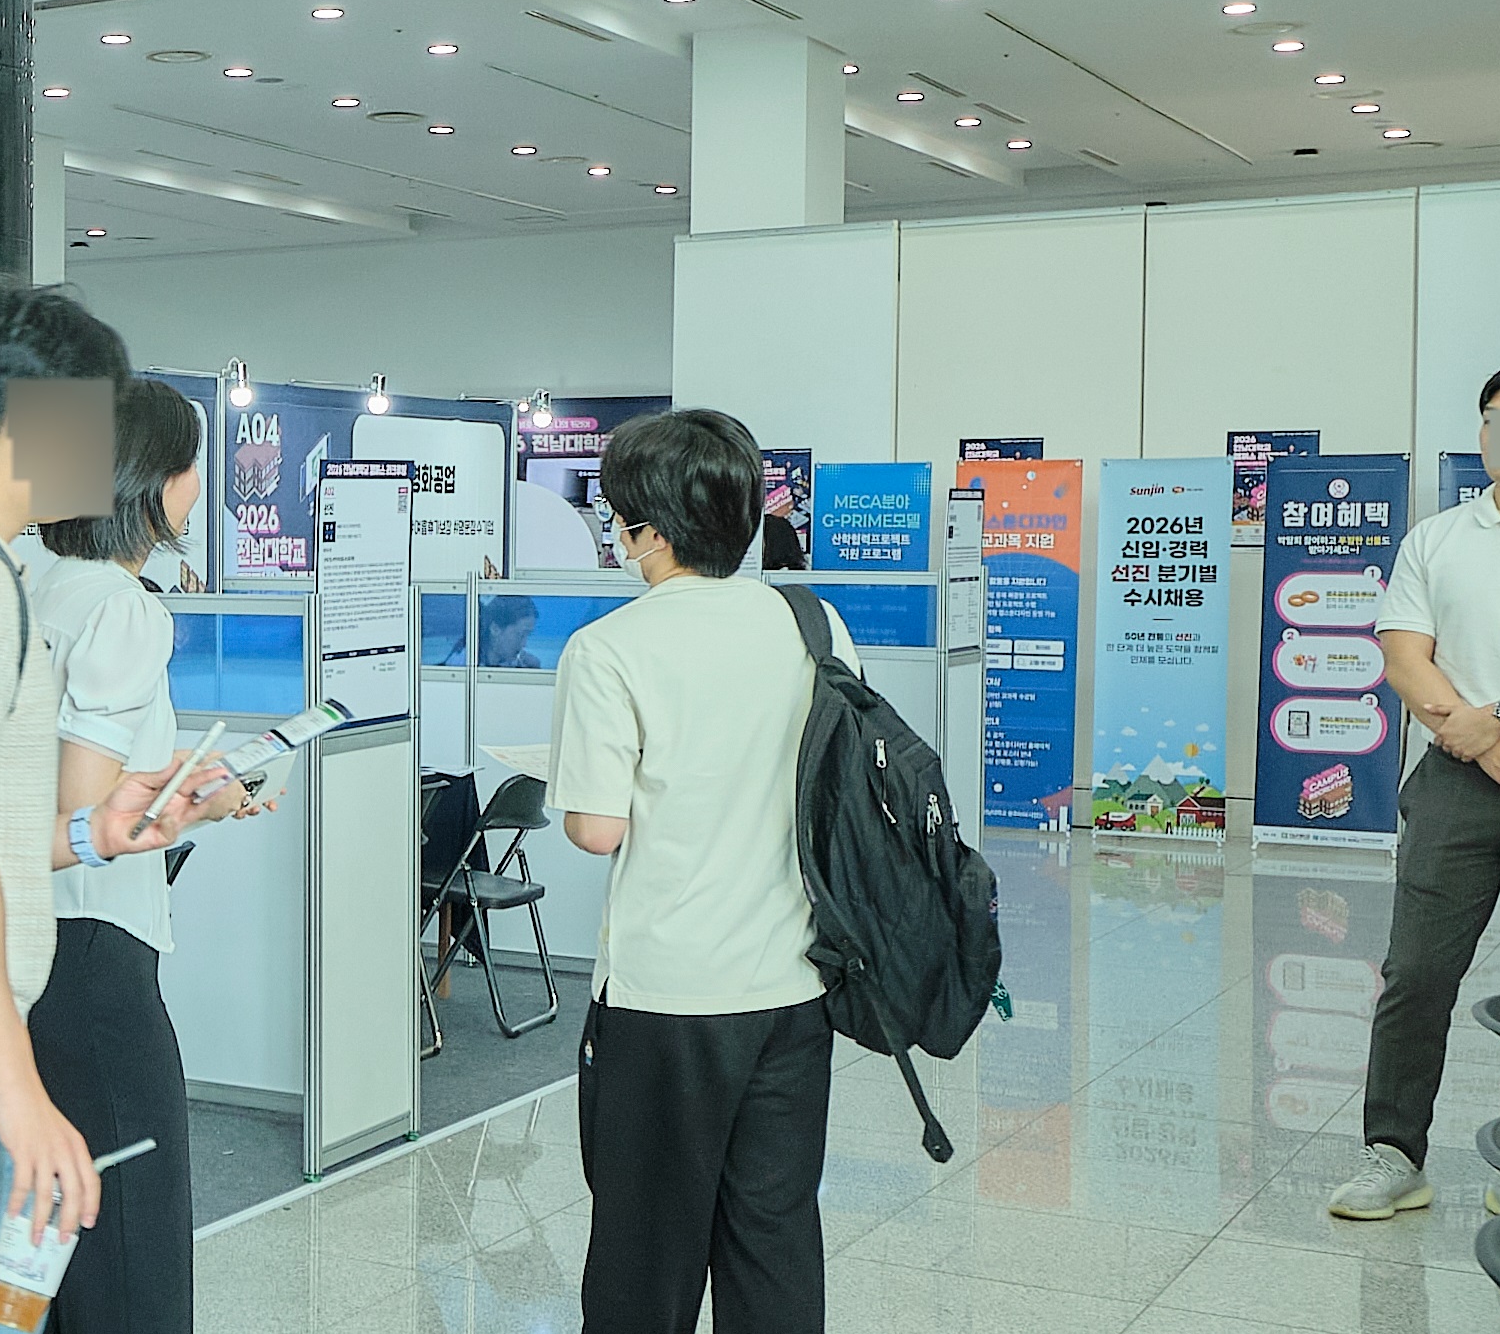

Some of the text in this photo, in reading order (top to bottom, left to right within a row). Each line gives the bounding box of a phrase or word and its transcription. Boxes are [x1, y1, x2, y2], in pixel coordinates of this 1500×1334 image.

[236, 413, 280, 446] A04
[833, 493, 910, 510] MECA분야
[237, 504, 280, 534] 2026
[822, 513, 921, 530] G-PRIME모델
[985, 513, 1068, 531] 스톤디자인
[1282, 500, 1390, 528] 참여혜택
[1126, 516, 1204, 535] 2026년
[831, 533, 911, 547] 산학협력프로젝트
[1026, 533, 1054, 549] 지원
[1121, 540, 1209, 559] 신입·경력
[236, 536, 307, 567] 전남대학교
[838, 548, 902, 561] 지원 프로그램
[1111, 564, 1218, 583] 선진 분기별
[1123, 588, 1205, 607] 수시채용
[1287, 631, 1294, 640] 2
[1365, 696, 1374, 705] 3
[1309, 766, 1349, 793] CAMPUS
